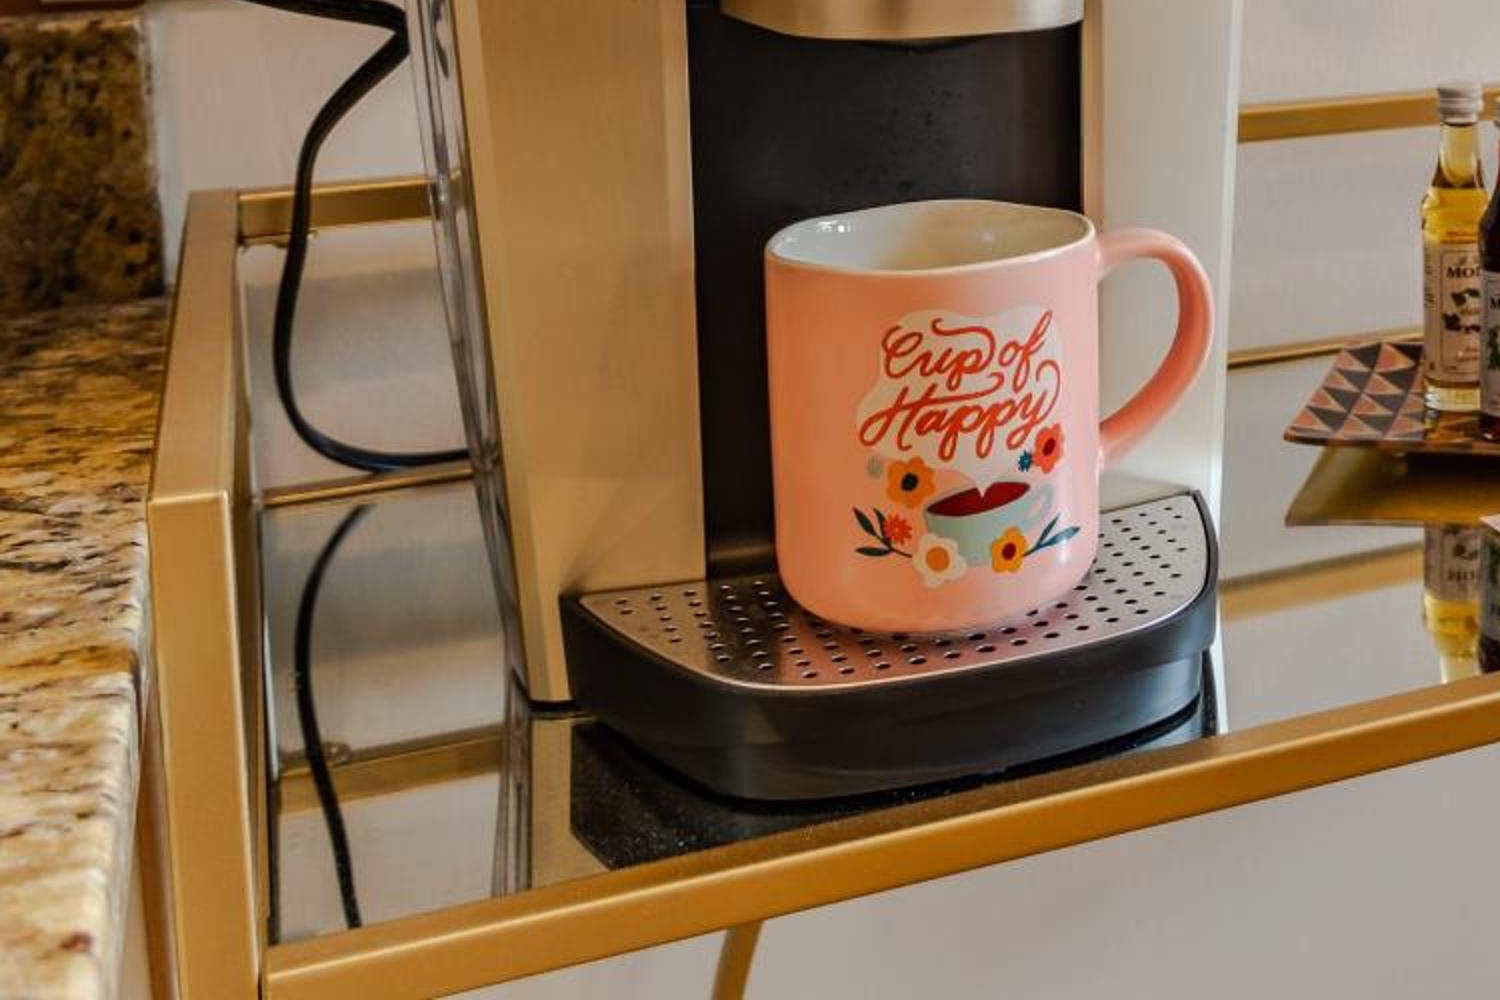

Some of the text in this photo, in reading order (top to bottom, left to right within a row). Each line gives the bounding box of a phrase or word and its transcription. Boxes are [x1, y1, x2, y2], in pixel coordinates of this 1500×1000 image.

[1446, 266, 1480, 278] MO
[882, 311, 1052, 392] Cup of
[859, 360, 1061, 462] Happy
